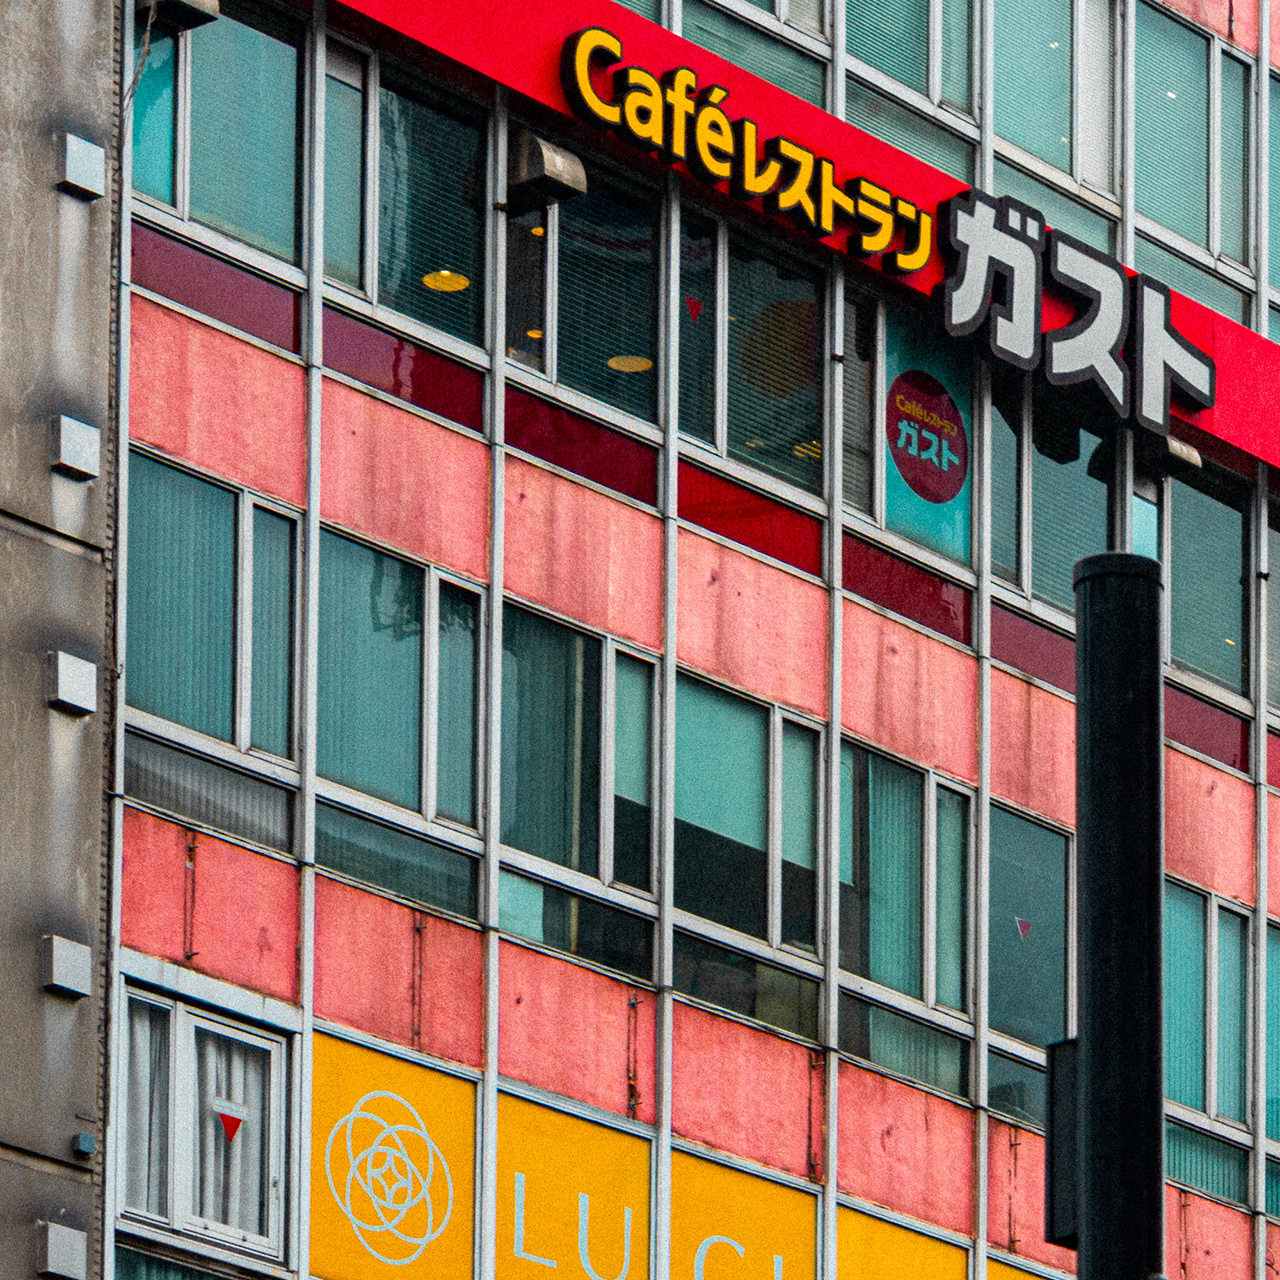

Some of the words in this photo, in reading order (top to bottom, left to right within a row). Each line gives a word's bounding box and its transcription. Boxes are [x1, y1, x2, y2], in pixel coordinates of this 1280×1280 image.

[951, 199, 1212, 426] ガスト
[897, 418, 960, 472] ガスト
